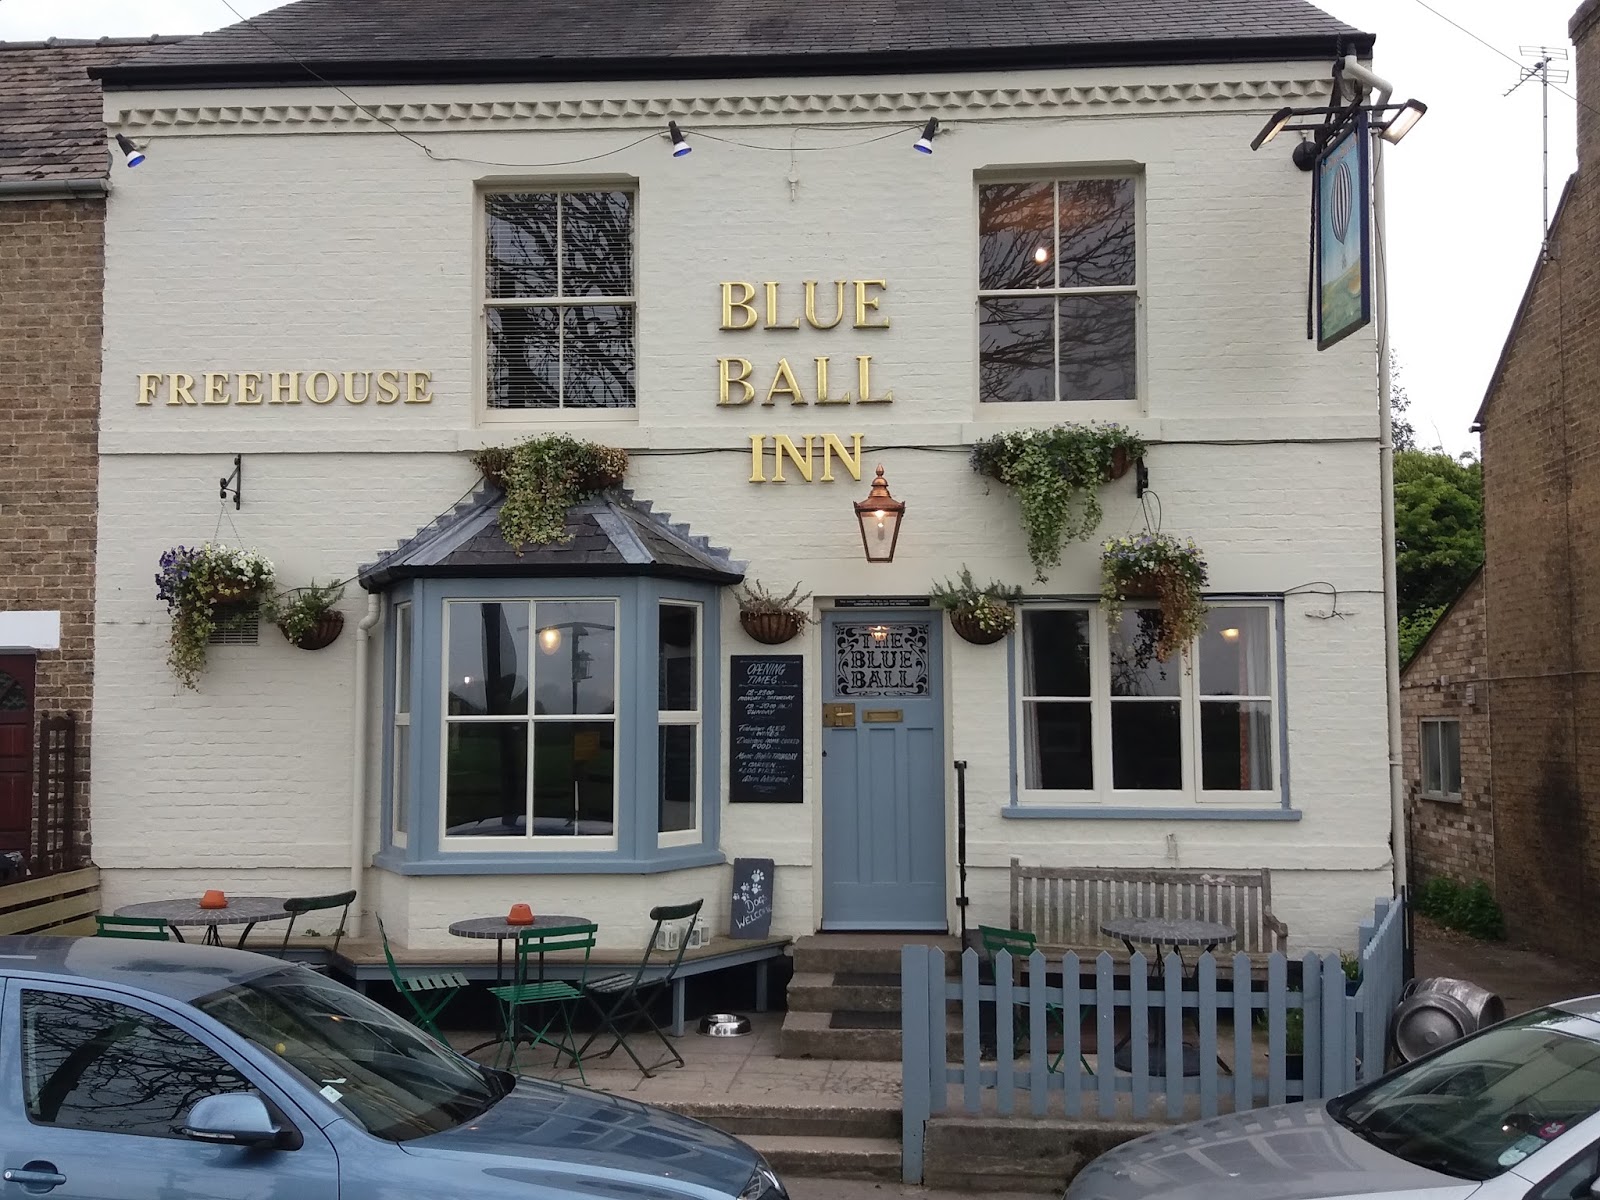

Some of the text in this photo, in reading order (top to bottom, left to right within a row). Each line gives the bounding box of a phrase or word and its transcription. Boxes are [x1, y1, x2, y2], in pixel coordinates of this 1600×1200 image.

[719, 278, 890, 331] BLUE
[135, 370, 434, 406] FREEHOUSE
[716, 355, 893, 407] BALL
[749, 432, 864, 482] INN
[858, 633, 904, 649] THE
[747, 663, 786, 676] OPENING
[851, 650, 913, 669] BLUE
[851, 670, 914, 689] BALL
